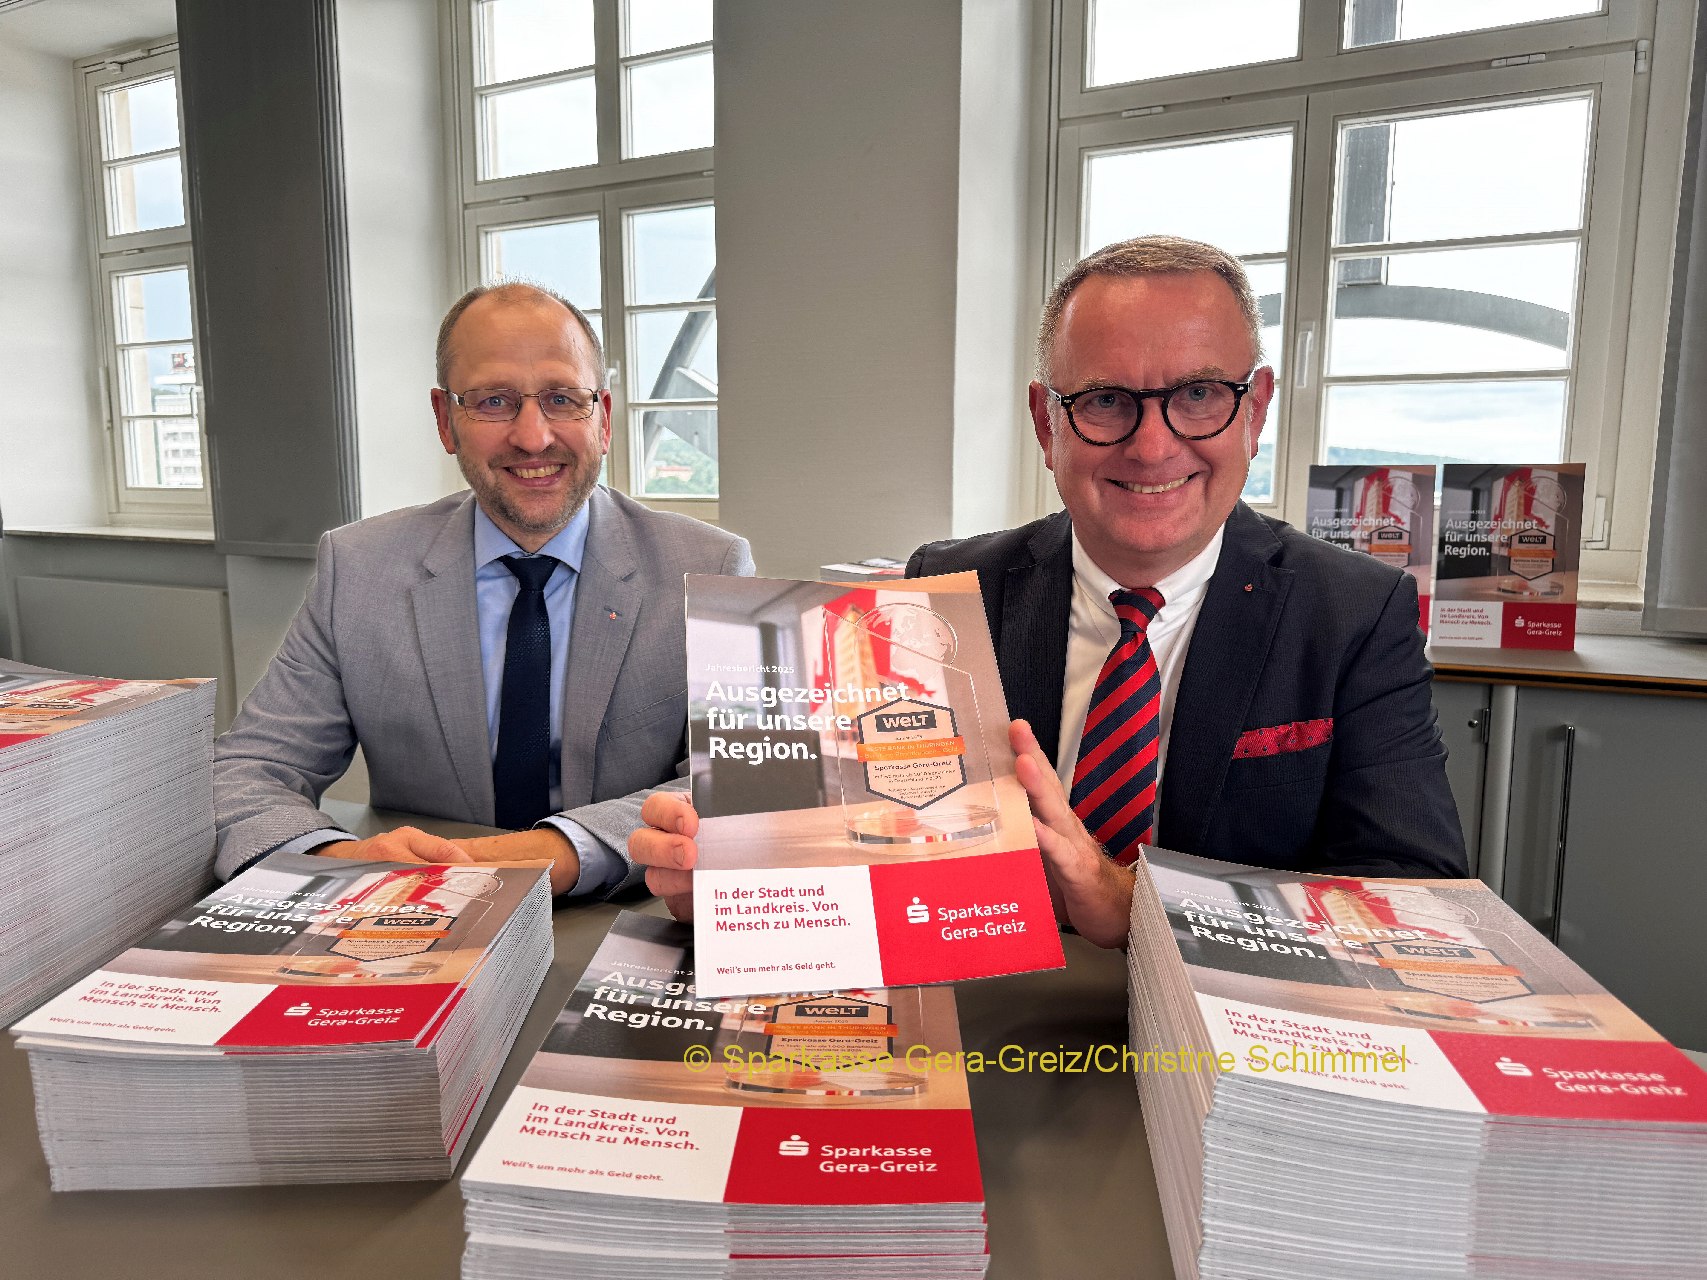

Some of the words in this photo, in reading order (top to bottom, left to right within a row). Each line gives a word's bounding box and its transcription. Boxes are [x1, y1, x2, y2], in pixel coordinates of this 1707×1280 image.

[1312, 516, 1395, 528] Ausgezeichnet
[1446, 518, 1538, 531] Ausgezeichnet
[1312, 528, 1329, 540] für
[1330, 531, 1369, 540] unsere
[1445, 531, 1463, 542] für
[1466, 534, 1508, 542] unsere
[1444, 544, 1490, 558] Region.
[1527, 621, 1561, 629] Sparkasse
[771, 665, 795, 674] 2025
[706, 681, 911, 708] Ausgezeichnet
[706, 707, 749, 731] für
[756, 714, 852, 731] unsere
[709, 736, 818, 765] Region.
[714, 888, 728, 900] In
[731, 887, 755, 900] der
[758, 886, 796, 899] Stadt
[798, 885, 825, 897] und
[220, 893, 430, 914] Ausgezeichnet
[714, 903, 732, 916] im
[736, 902, 809, 915] Landkreis.
[812, 900, 839, 912] Von
[937, 901, 1019, 922] Sparkasse
[206, 904, 252, 917] für
[254, 911, 353, 924] unsere
[1180, 898, 1428, 940] Ausgezeichnet
[188, 916, 297, 935] Region.
[715, 919, 770, 932] Mensch
[773, 920, 790, 929] zu
[793, 915, 851, 928] Mensch.
[941, 920, 1027, 941] Gera-Greiz
[1182, 910, 1234, 930] für
[1243, 926, 1363, 949] unsere
[1190, 924, 1327, 960] Region.
[716, 965, 742, 975] Weil's
[758, 964, 780, 972] mehr
[781, 963, 793, 971] als
[795, 962, 814, 970] Geld
[815, 961, 836, 971] geht.
[89, 987, 110, 996] im
[112, 989, 188, 1003] Landkreis.
[194, 997, 222, 1005] Von
[118, 982, 143, 991] der
[145, 985, 186, 994] Stadt
[79, 996, 136, 1007] Mensch
[161, 1003, 222, 1013] Mensch.
[594, 985, 645, 1005] für
[651, 997, 767, 1015] unsere
[315, 1005, 405, 1019] Sparkasse
[583, 1003, 714, 1031] Region.
[307, 1015, 400, 1028] Gera-Greiz
[1224, 1008, 1242, 1018] In
[1247, 1013, 1277, 1025] der
[1281, 1019, 1331, 1035] Stadt
[1336, 1029, 1372, 1041] und
[1228, 1017, 1252, 1029] im
[1256, 1023, 1354, 1048] Landkreis.
[1357, 1040, 1397, 1054] Von
[1233, 1028, 1305, 1049] Mensch
[1543, 1066, 1666, 1083] Sparkasse
[1555, 1079, 1688, 1098] Gera-Greiz
[532, 1102, 549, 1112] In
[554, 1105, 586, 1117] der
[588, 1109, 638, 1122] Stadt
[642, 1115, 677, 1125] und
[525, 1113, 549, 1124] im
[554, 1116, 649, 1134] Landkreis.
[655, 1126, 690, 1137] Von
[519, 1125, 591, 1141] Mensch
[595, 1135, 618, 1144] zu
[622, 1136, 701, 1150] Mensch.
[821, 1145, 932, 1159] Sparkasse
[557, 1166, 584, 1174] mehr
[589, 1168, 605, 1176] als
[607, 1170, 633, 1178] Geld
[635, 1172, 664, 1181] geht.
[819, 1160, 938, 1174] Gera-Greiz
